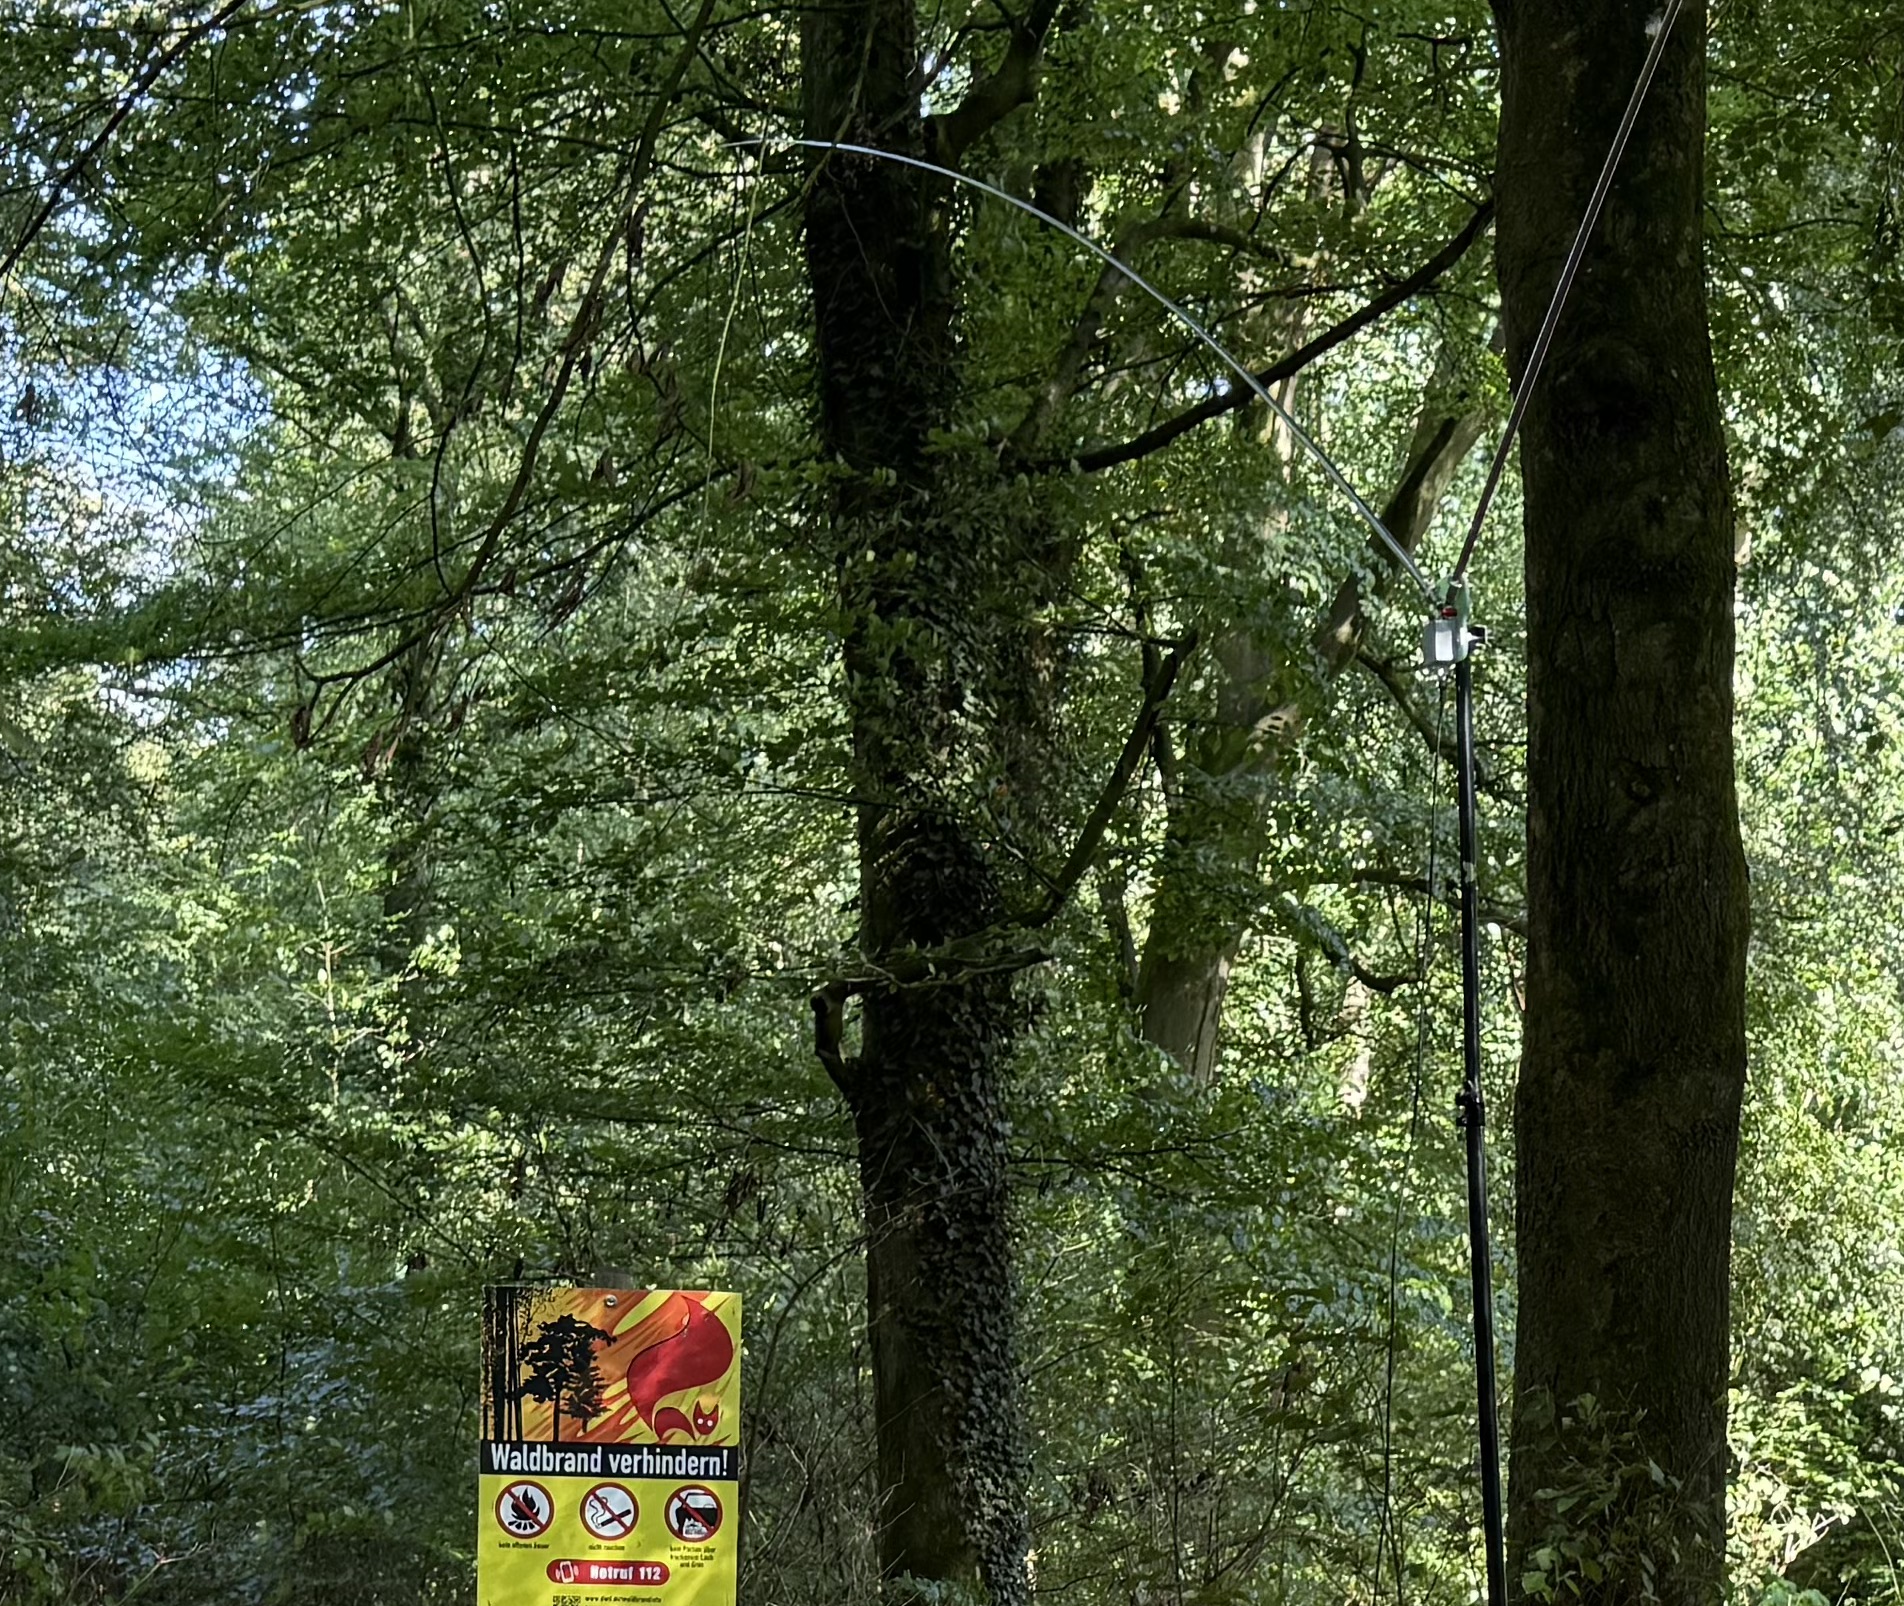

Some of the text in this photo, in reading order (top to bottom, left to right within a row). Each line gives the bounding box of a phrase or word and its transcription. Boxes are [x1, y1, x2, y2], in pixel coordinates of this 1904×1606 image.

[490, 1443, 729, 1476] Waldbrand verhindern!
[589, 1564, 662, 1581] Notruf 112
